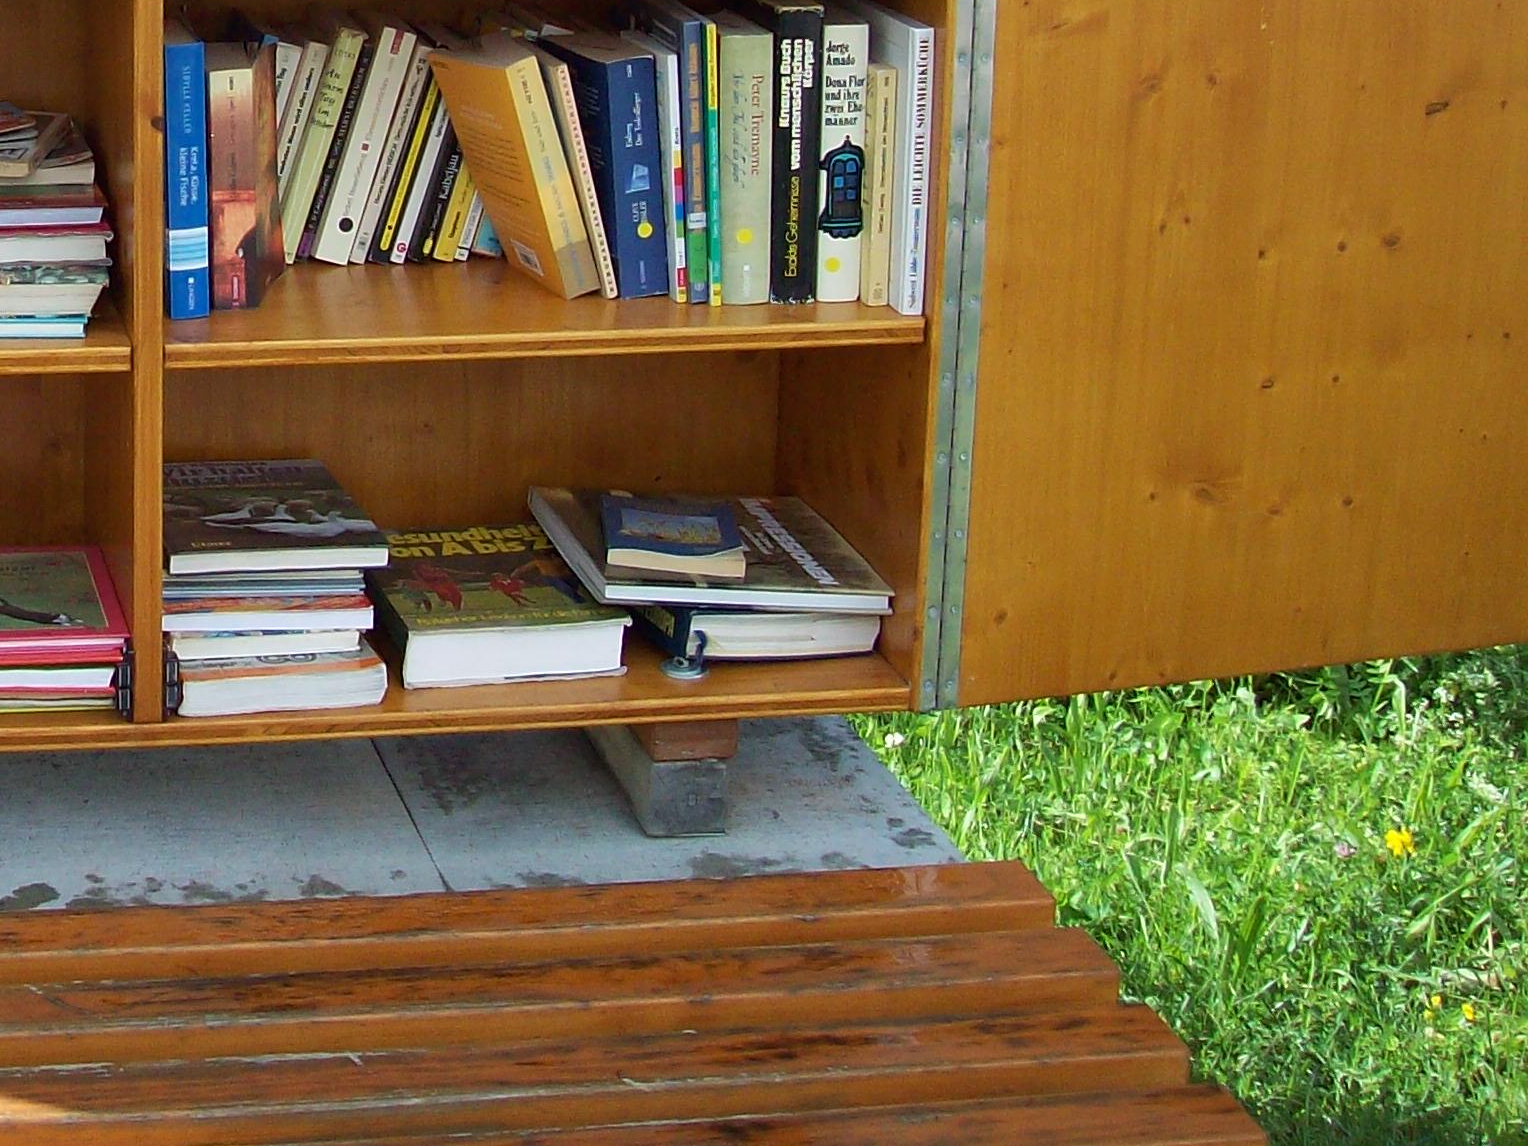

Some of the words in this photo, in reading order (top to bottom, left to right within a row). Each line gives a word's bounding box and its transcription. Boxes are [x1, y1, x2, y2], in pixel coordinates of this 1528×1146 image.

[779, 39, 791, 74] Buch
[802, 38, 815, 88] Körper
[751, 74, 764, 108] Peter
[790, 38, 805, 138] menschlichen
[825, 90, 841, 101] und
[848, 76, 866, 88] Flor
[779, 76, 790, 128] Knaurs
[750, 111, 764, 177] Tremayne
[791, 139, 801, 170] vom
[911, 134, 925, 181] LEICHTE
[179, 147, 189, 176] kleine
[179, 177, 189, 207] Fische
[911, 184, 923, 206] DIE
[441, 542, 471, 556] A
